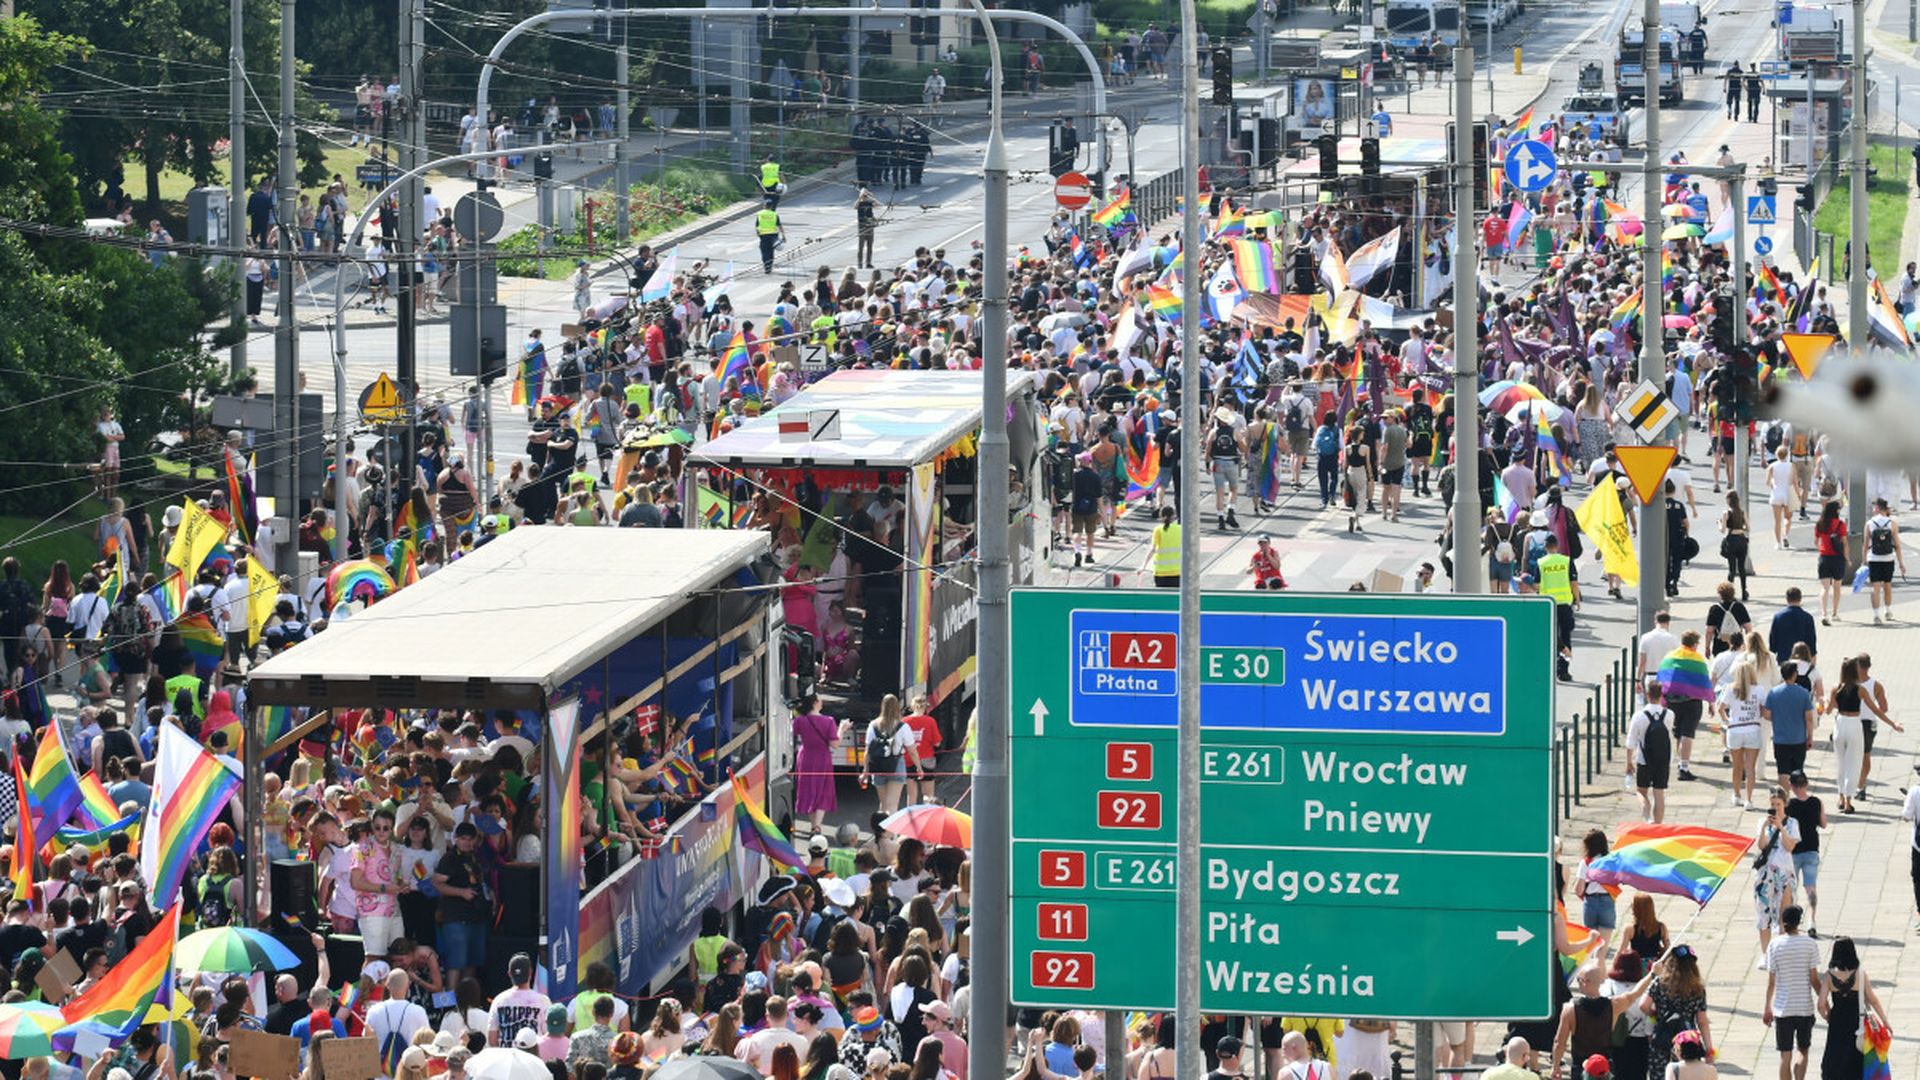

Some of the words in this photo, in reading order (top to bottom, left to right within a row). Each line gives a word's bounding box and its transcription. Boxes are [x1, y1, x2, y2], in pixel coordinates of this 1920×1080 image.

[1124, 640, 1163, 664] A2
[1304, 620, 1458, 664] Świecko
[1209, 654, 1224, 678] E
[1233, 654, 1270, 679] 30
[1096, 674, 1158, 691] Płatna
[1301, 679, 1491, 714] Warszawa
[1122, 750, 1138, 774] 5
[1204, 752, 1219, 776] E
[1226, 752, 1270, 778] 261
[1302, 751, 1467, 786] Wrocław
[1112, 798, 1147, 823] 92
[1304, 800, 1432, 844] Pniewy
[1055, 858, 1071, 881] 5
[1108, 859, 1123, 883] E
[1130, 860, 1174, 885] 261
[1209, 859, 1400, 902] Bydgoszcz
[1051, 910, 1073, 934] 11
[1209, 912, 1280, 945] Piła
[1046, 958, 1080, 983] 92
[1206, 960, 1374, 997] Września
[497, 1006, 540, 1024] TRIPPY
